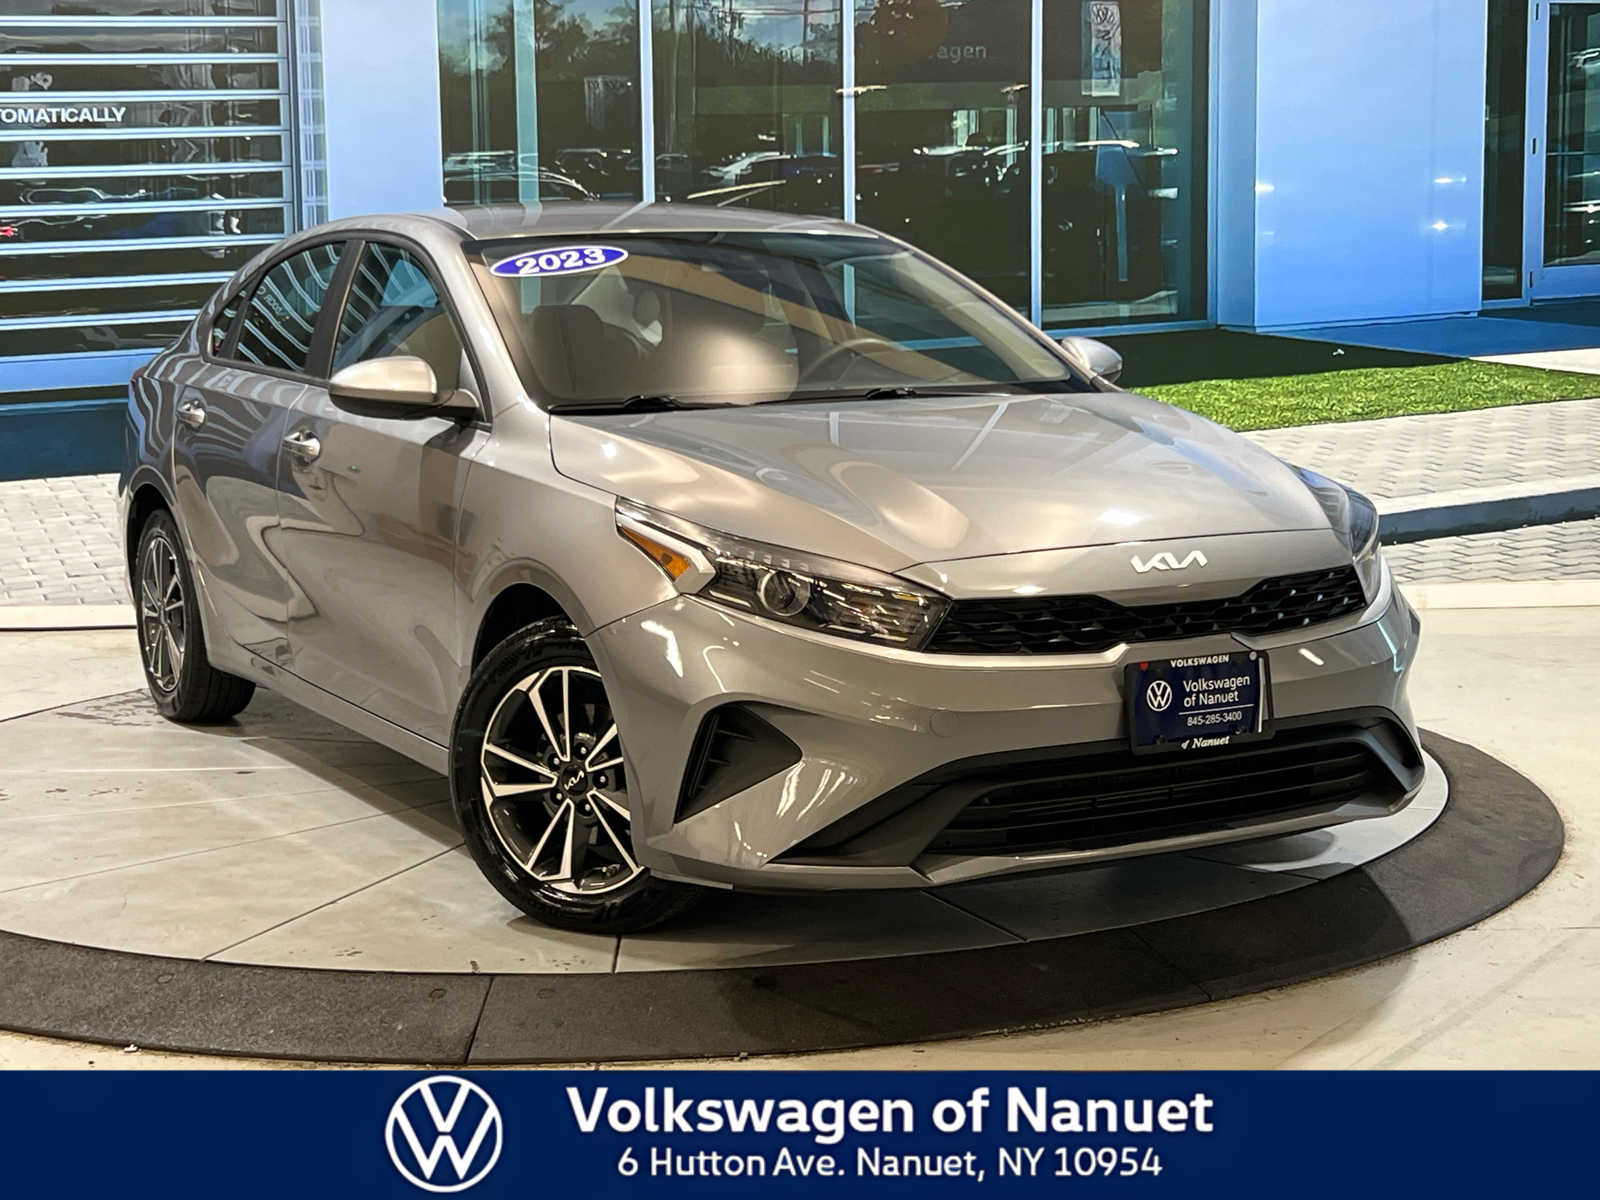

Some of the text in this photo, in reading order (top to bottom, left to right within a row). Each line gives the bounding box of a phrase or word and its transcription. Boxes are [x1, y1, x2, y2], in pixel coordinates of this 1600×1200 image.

[515, 248, 606, 275] 2023
[1130, 550, 1209, 573] KIA
[1170, 654, 1230, 668] VOLKSWAGEN
[1183, 675, 1251, 692] Volkswagen
[1183, 691, 1239, 707] of Nanuet
[1186, 711, 1242, 726] 845-285-3400
[1192, 736, 1230, 749] Nanuet
